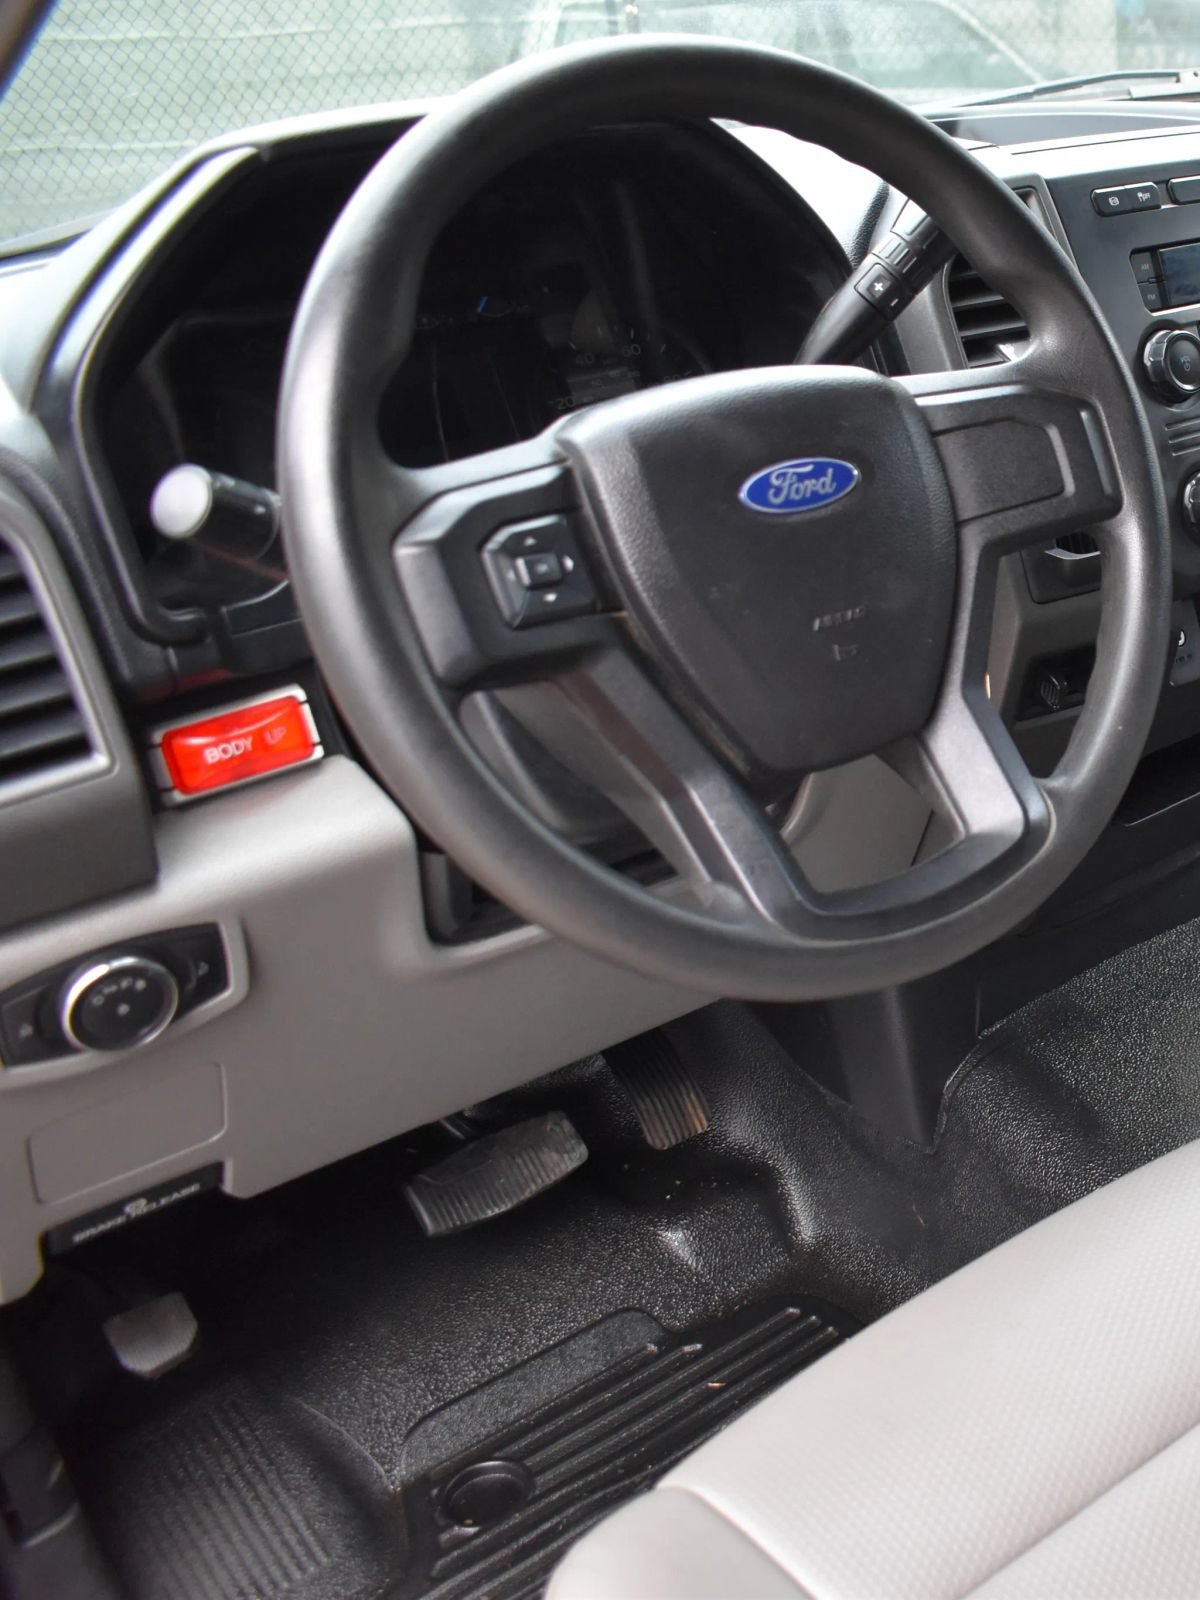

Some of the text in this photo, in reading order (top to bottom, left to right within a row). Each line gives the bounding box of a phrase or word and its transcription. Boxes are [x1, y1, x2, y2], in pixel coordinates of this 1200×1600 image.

[768, 463, 837, 505] Ford
[204, 727, 287, 765] BODY UP
